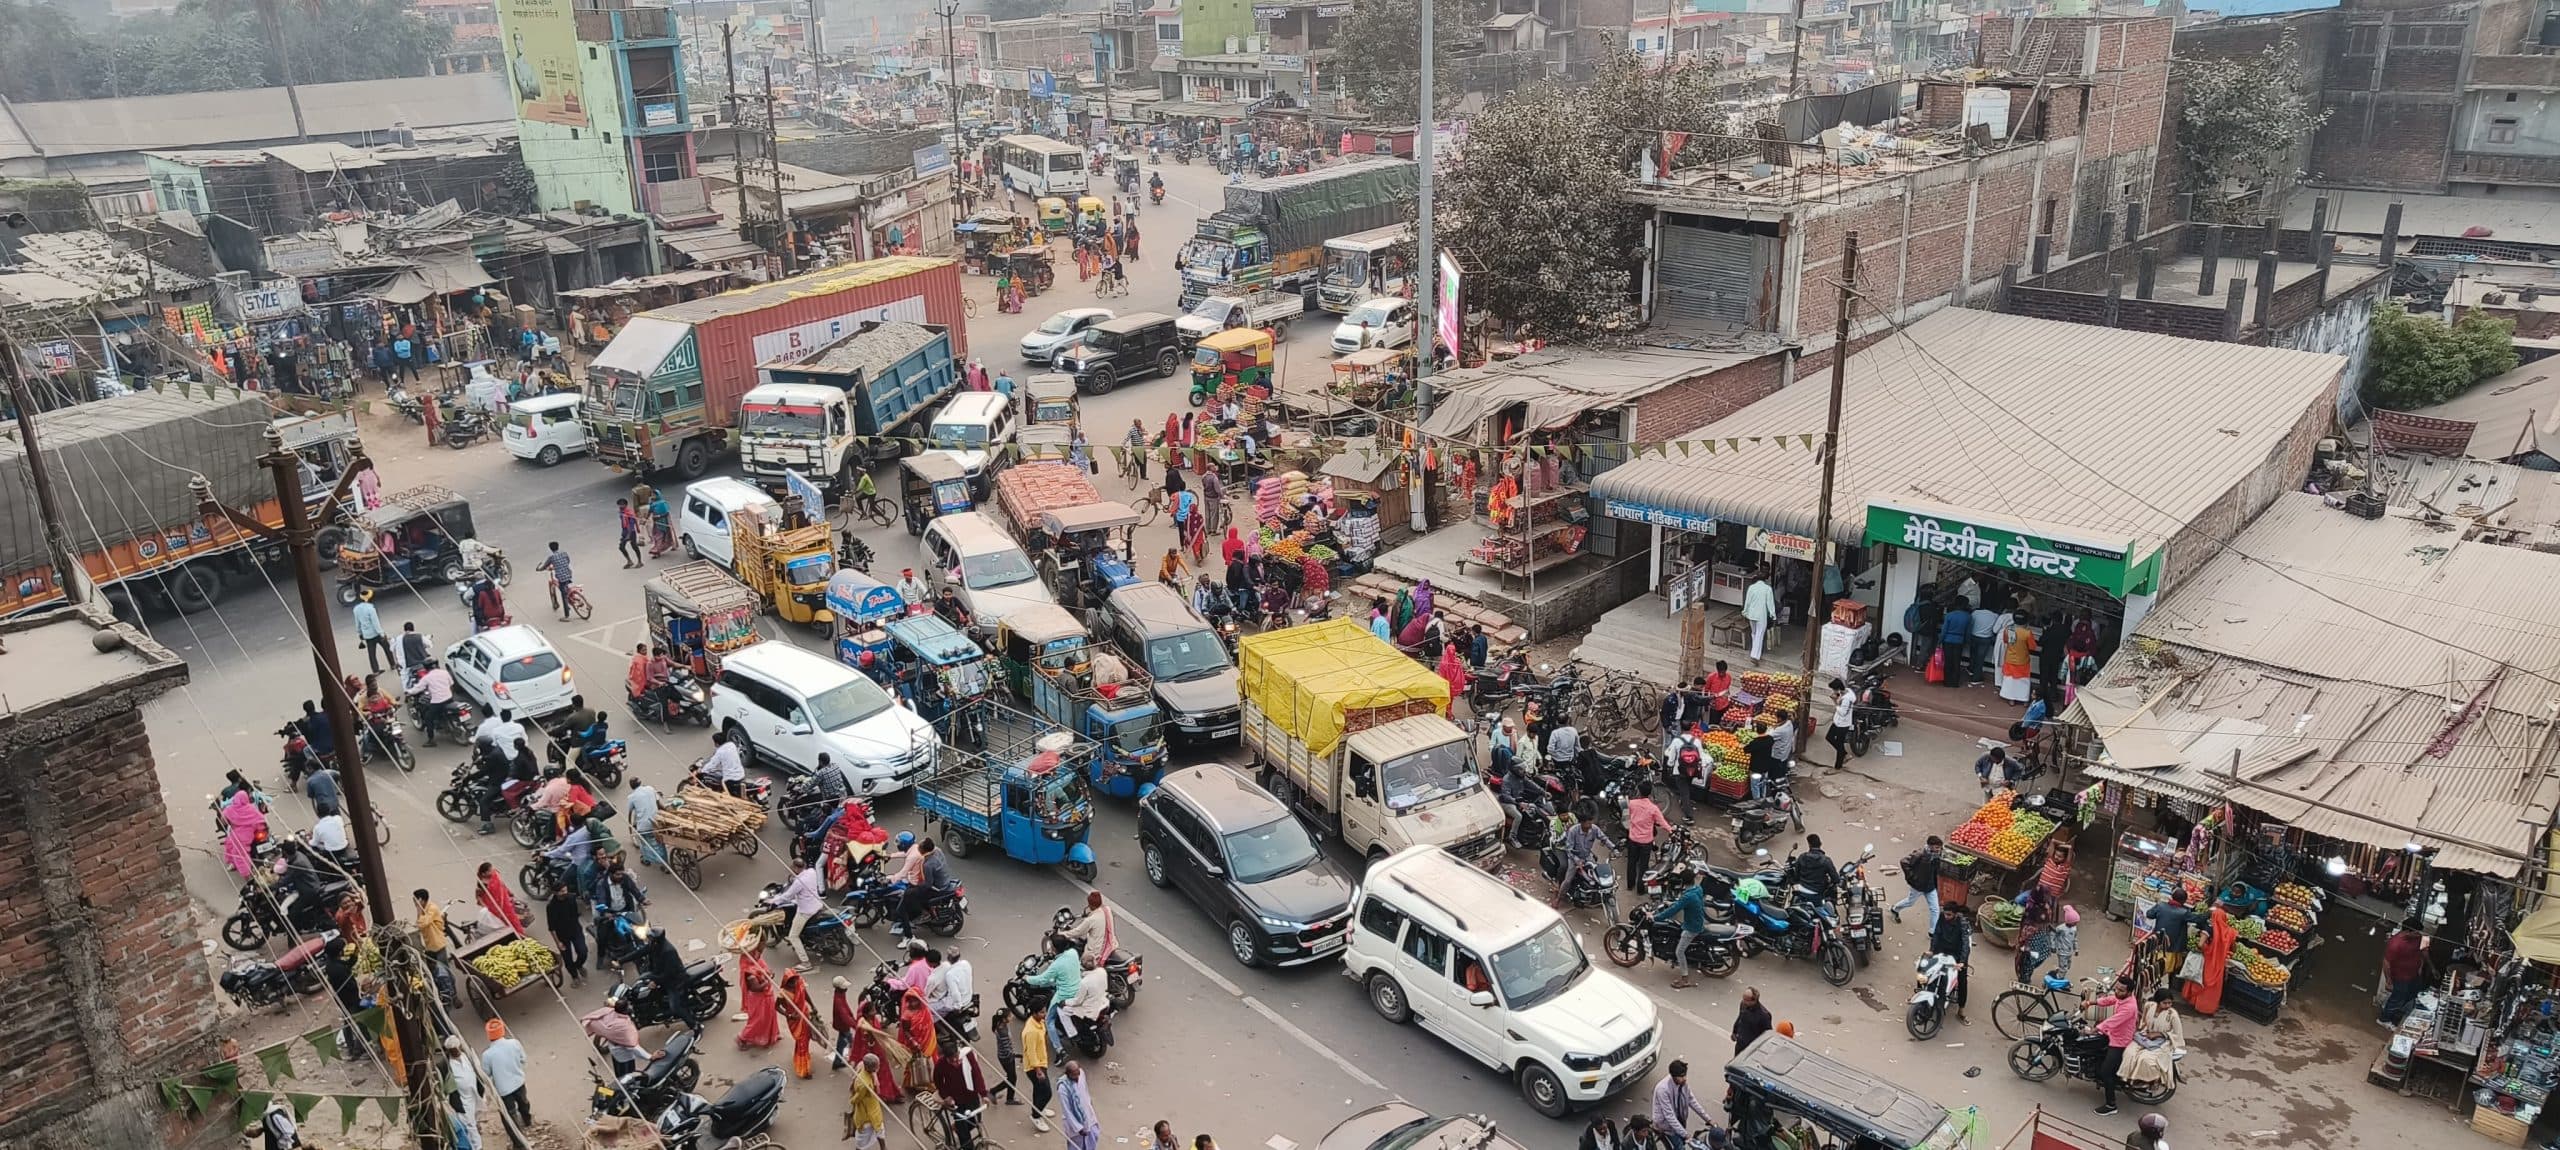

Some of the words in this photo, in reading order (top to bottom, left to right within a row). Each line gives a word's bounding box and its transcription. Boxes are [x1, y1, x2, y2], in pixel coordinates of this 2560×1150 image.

[245, 292, 280, 311] STYLE
[789, 333, 801, 348] B
[831, 321, 841, 338] F
[775, 345, 814, 364] BARODA
[1613, 504, 1644, 521] गोपाल
[1646, 508, 1683, 528] मेडिकल
[1904, 516, 1998, 563] मेडिसीन
[2006, 535, 2080, 579] सेन्टर
